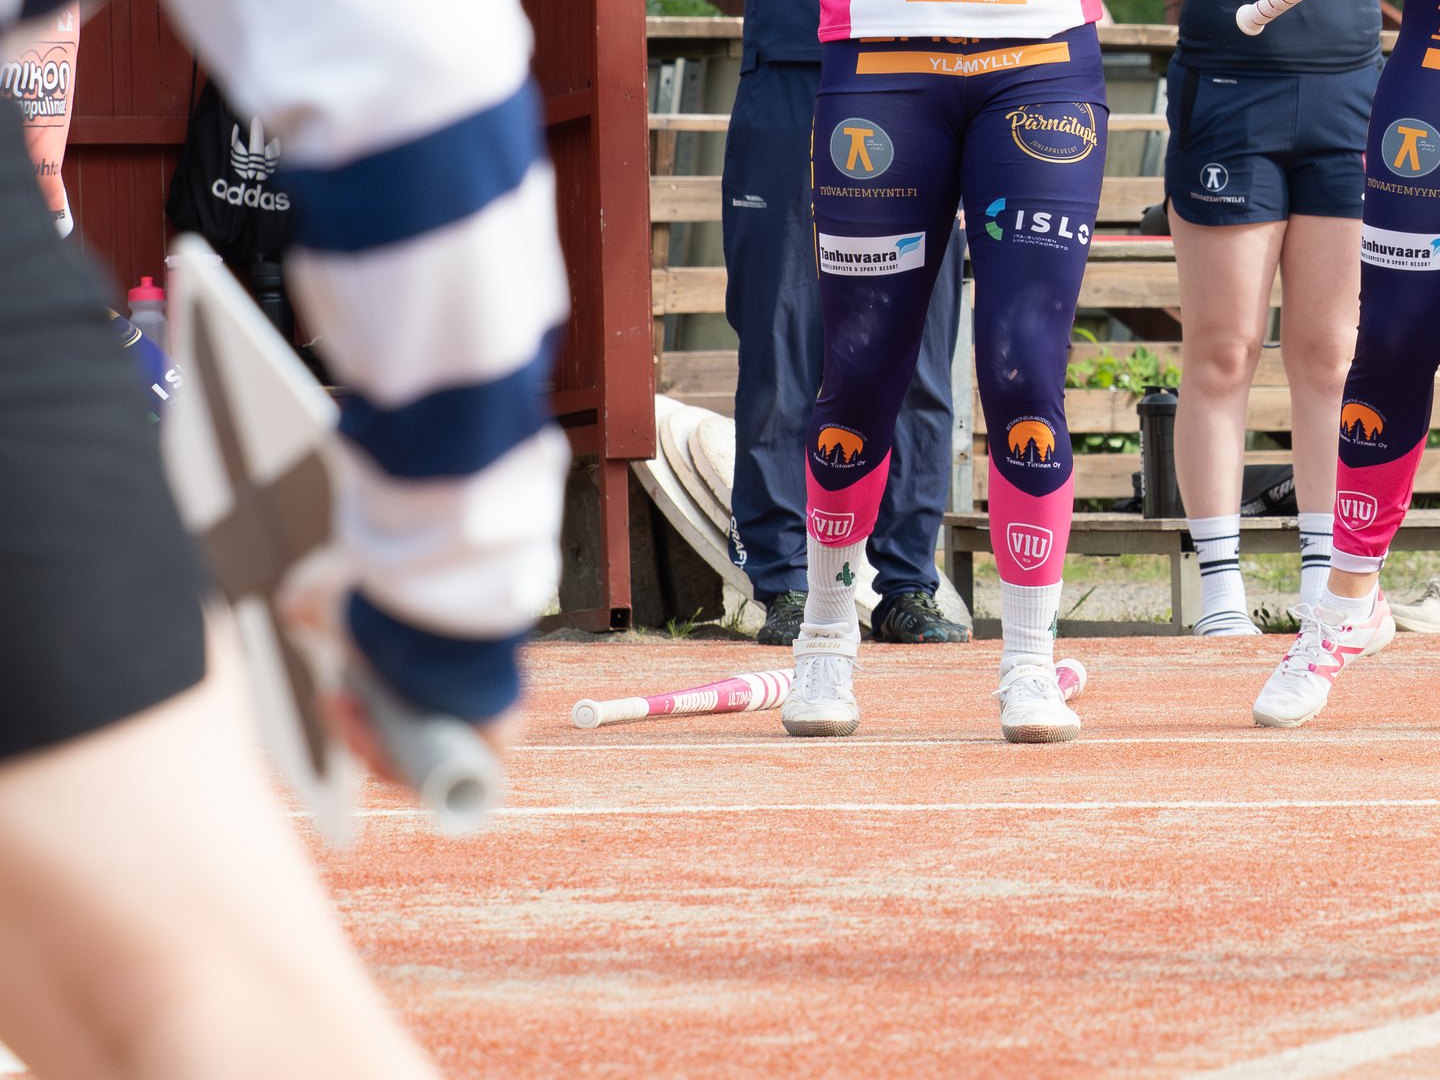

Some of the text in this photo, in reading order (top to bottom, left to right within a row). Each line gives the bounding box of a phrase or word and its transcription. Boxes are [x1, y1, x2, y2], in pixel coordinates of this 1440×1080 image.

[929, 52, 1024, 74] YLÄMYLLY
[1005, 110, 1098, 147] Pärnätupa
[819, 185, 918, 198] TYÖVAATEMYYNTI.FI
[820, 246, 897, 264] Tanhuvaara
[1340, 499, 1373, 521] VIU
[814, 516, 849, 536] VIU
[1012, 532, 1047, 559] VIU
